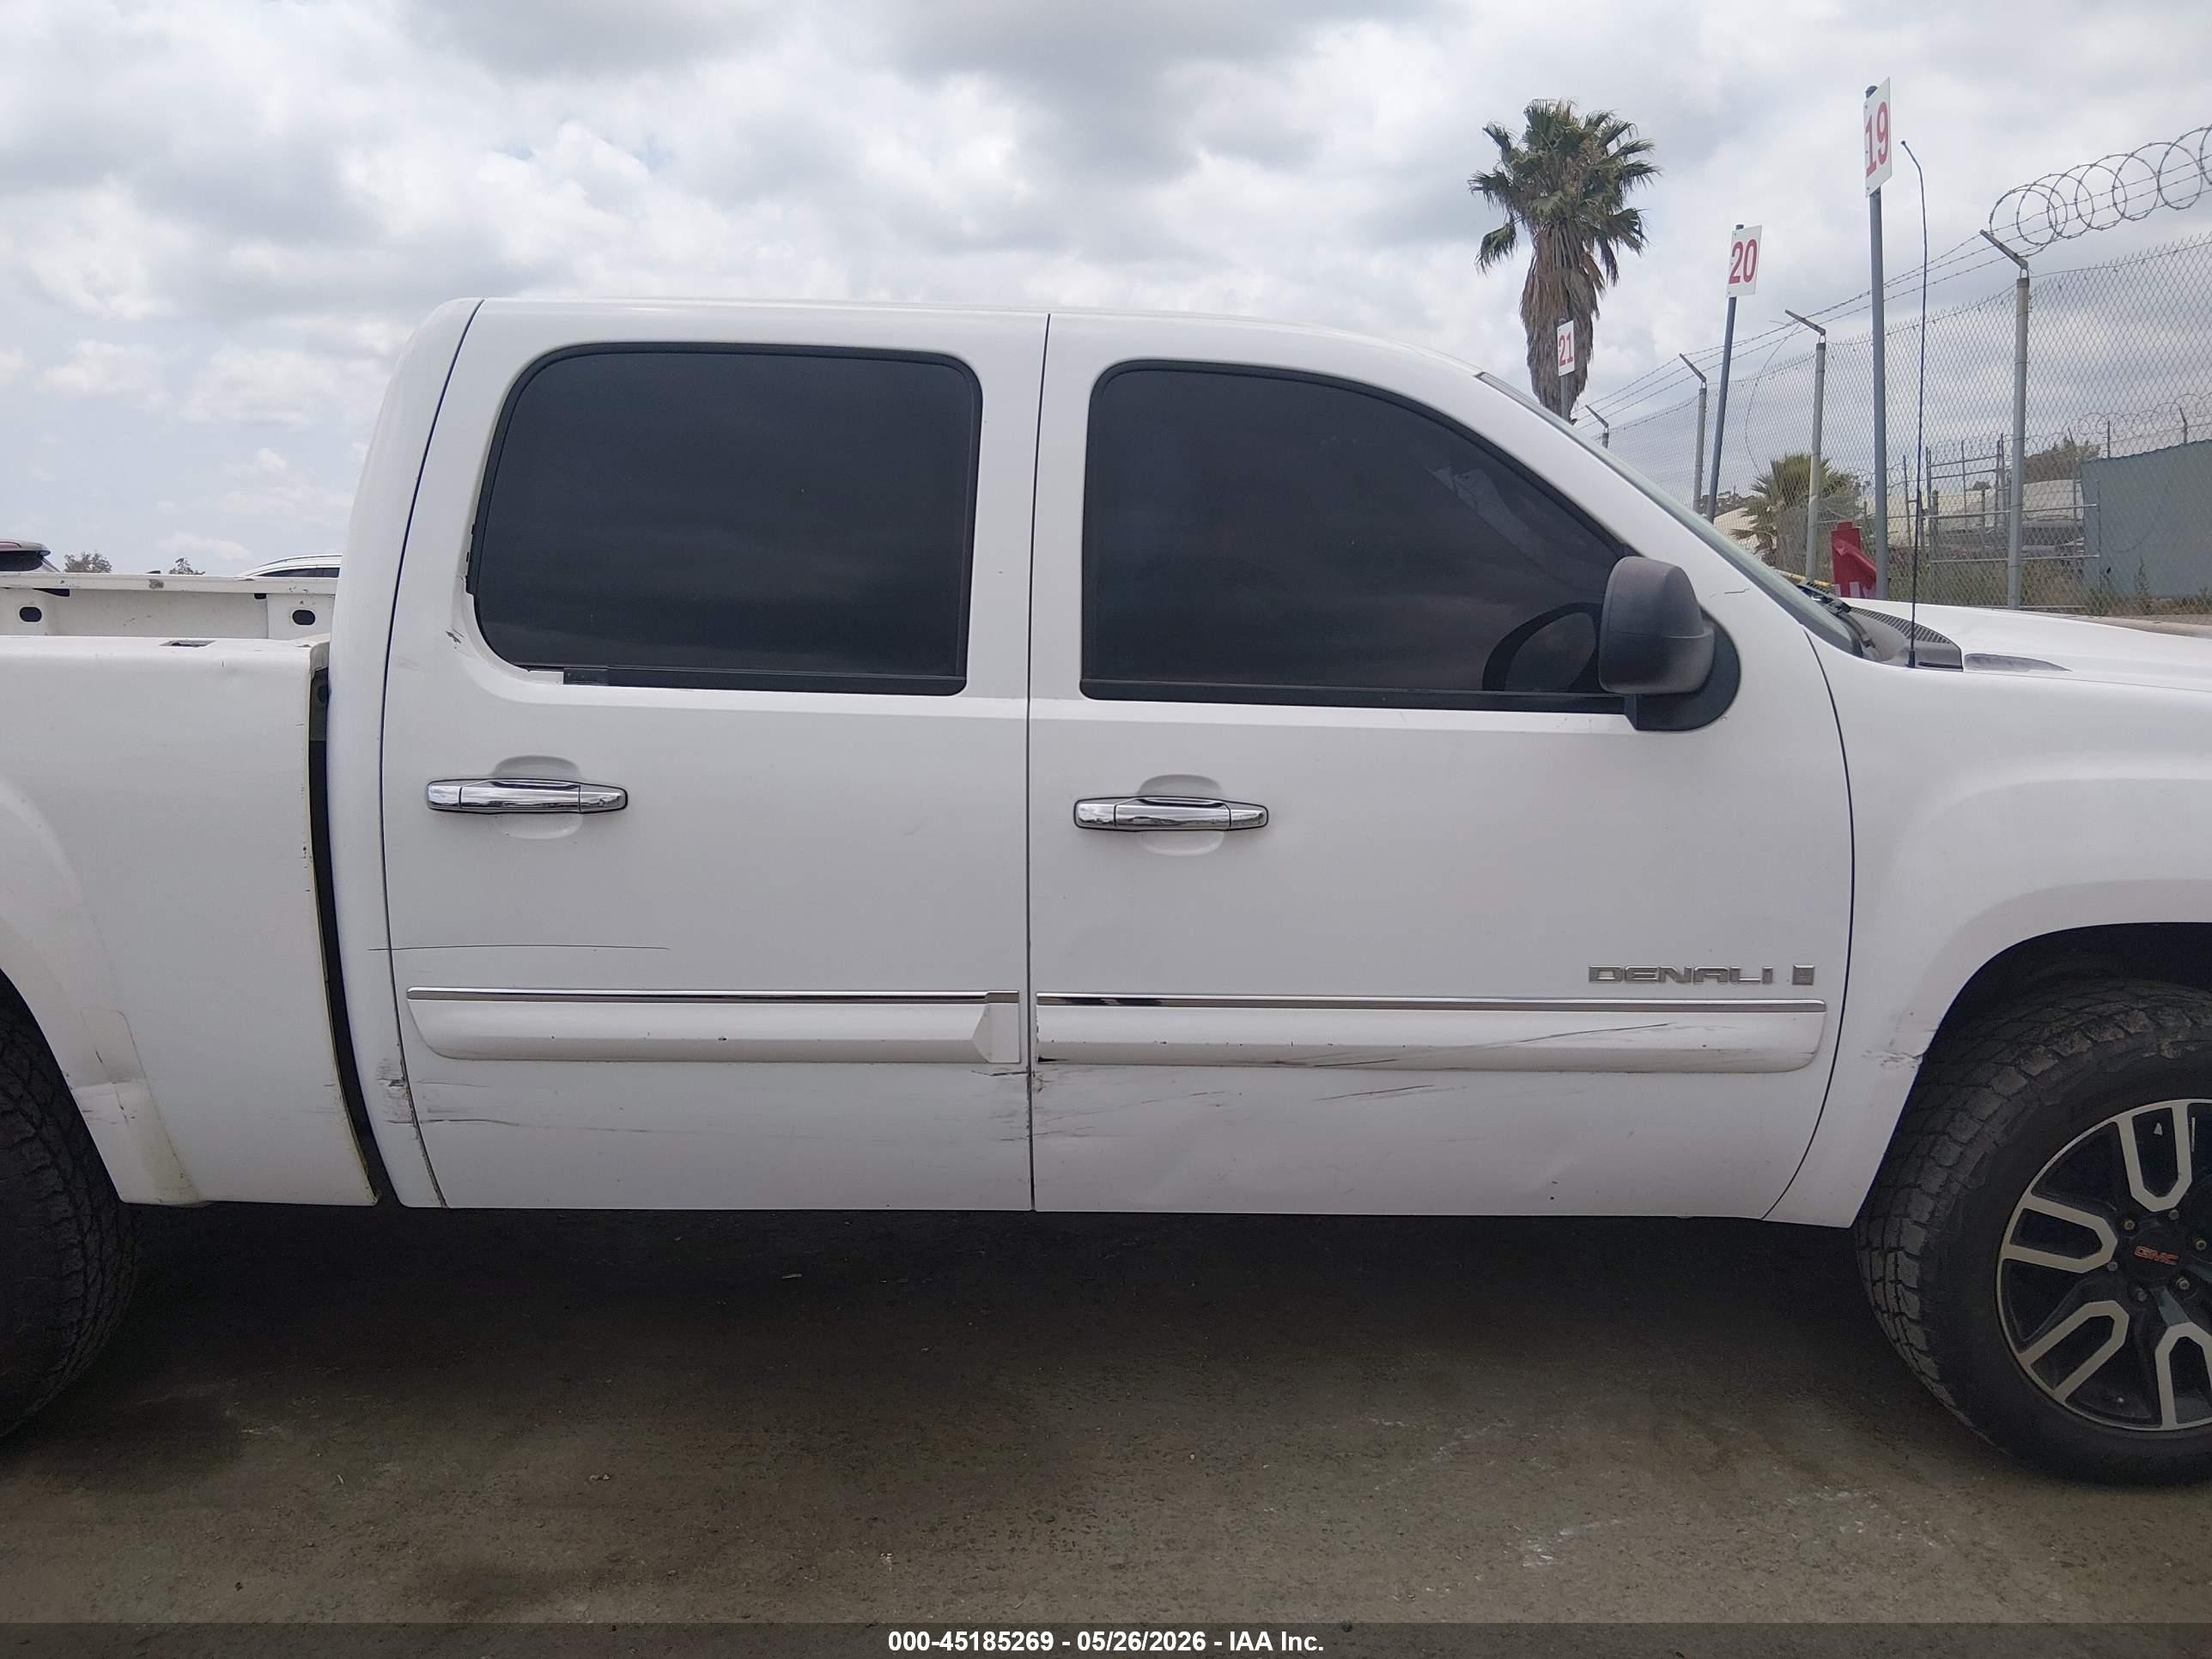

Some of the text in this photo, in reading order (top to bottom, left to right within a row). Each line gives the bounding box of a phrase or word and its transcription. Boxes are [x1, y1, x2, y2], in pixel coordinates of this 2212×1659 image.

[1866, 101, 1890, 178] 19
[1729, 239, 1759, 284] 20
[1559, 331, 1573, 366] 21
[1588, 965, 1773, 984] DENALI
[2135, 1245, 2179, 1266] GMC
